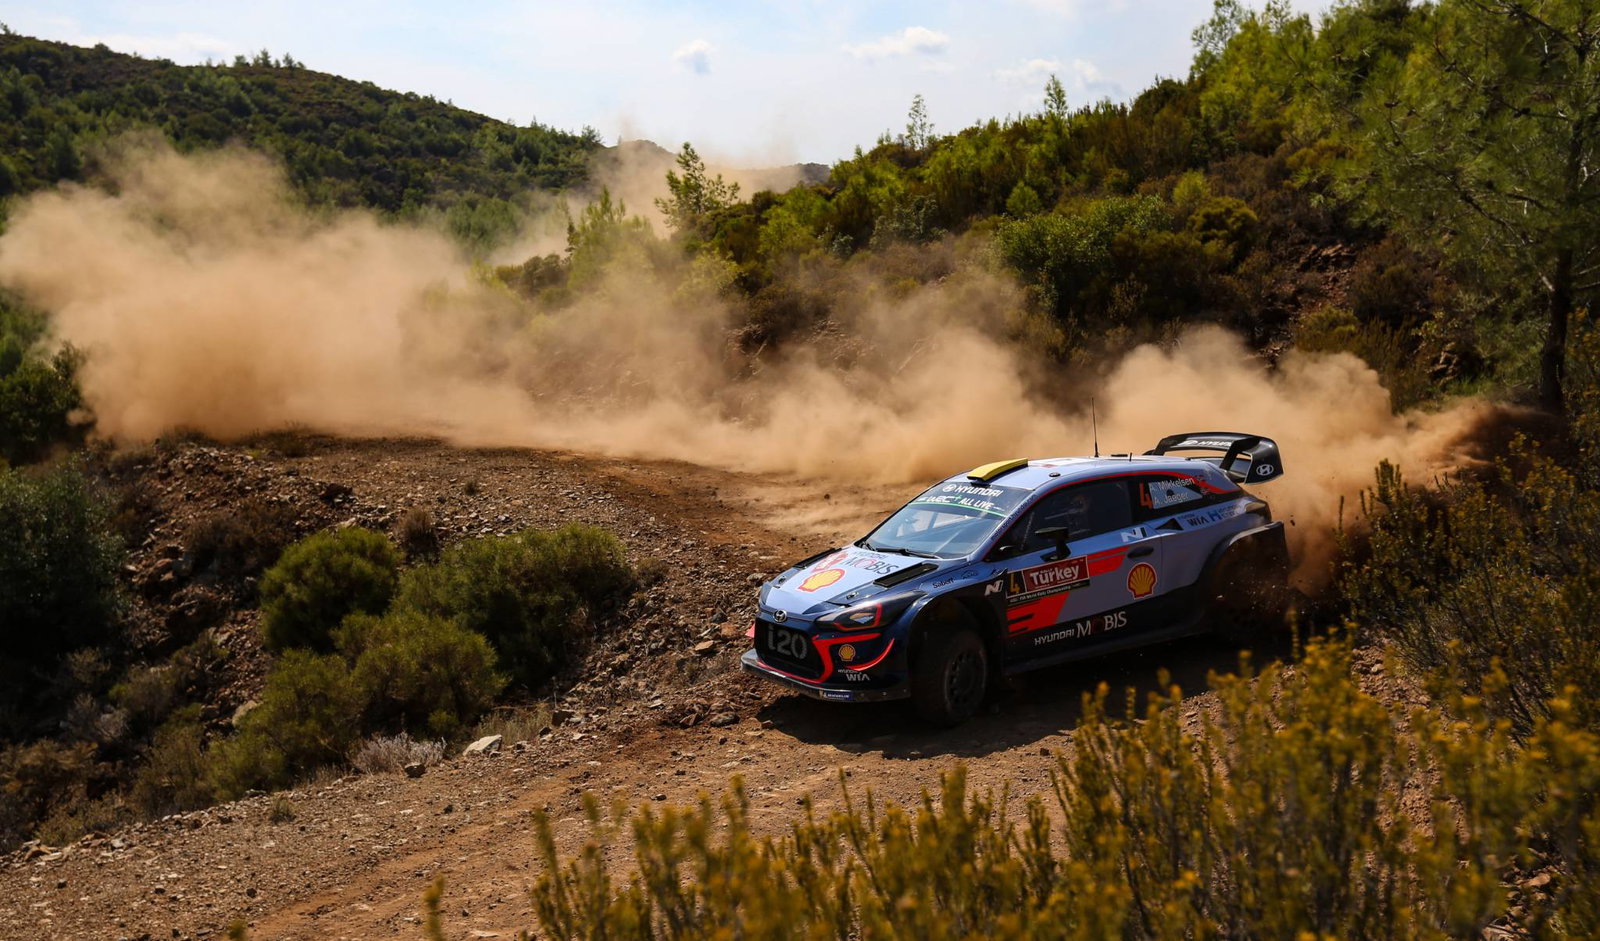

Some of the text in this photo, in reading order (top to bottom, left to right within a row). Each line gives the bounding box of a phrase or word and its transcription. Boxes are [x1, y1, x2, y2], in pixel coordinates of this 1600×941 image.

[1158, 477, 1196, 490] Mikkelsen
[954, 486, 1004, 497] HYUNDAI
[1139, 482, 1154, 509] 4
[1164, 492, 1189, 504] Jaeger
[959, 497, 974, 506] ALL
[973, 500, 995, 510] LIVE
[1187, 515, 1210, 527] WIA
[1010, 573, 1021, 595] 4
[768, 623, 808, 659] i20
[1034, 628, 1075, 646] HYUNDAI
